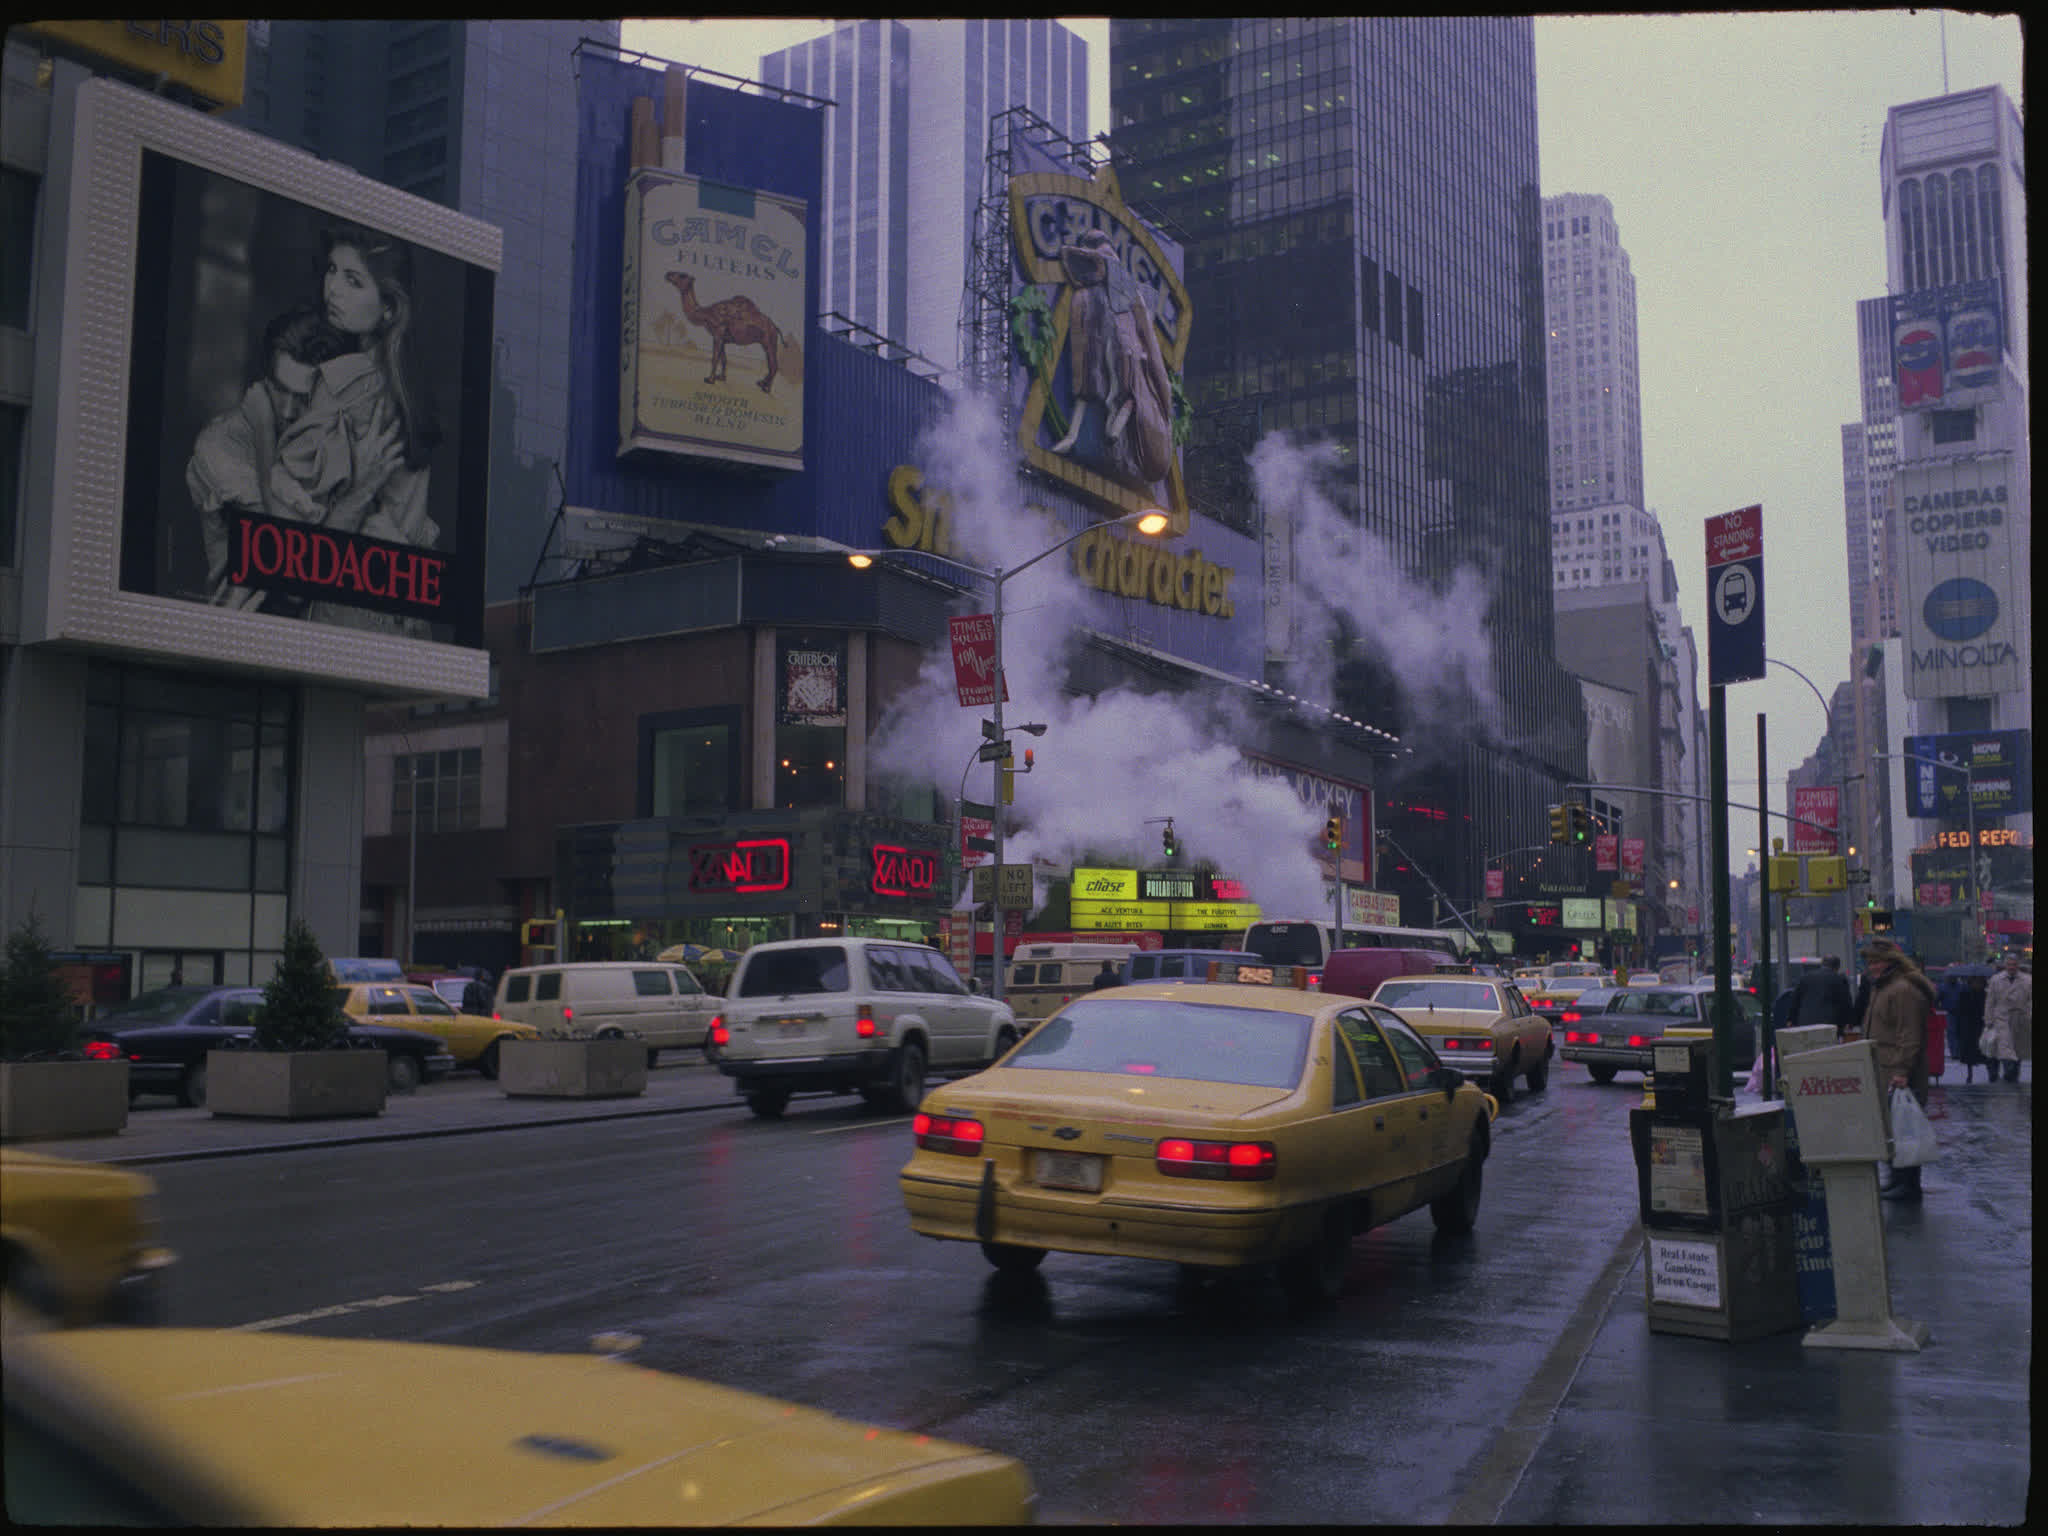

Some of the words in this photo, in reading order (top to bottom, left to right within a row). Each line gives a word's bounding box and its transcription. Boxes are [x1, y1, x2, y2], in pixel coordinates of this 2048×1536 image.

[651, 216, 799, 280] CAMEL
[677, 249, 776, 281] FILTERS
[1904, 486, 2008, 514] CAMERAS
[1724, 514, 1743, 530] NO
[1910, 508, 2002, 534] COPIERS
[1713, 527, 1755, 548] STANDING
[1926, 532, 1989, 555] VIDEO
[232, 519, 441, 607] JORDACHE
[952, 619, 993, 634] TIMES
[953, 631, 994, 646] SQUARE
[788, 654, 837, 667] CRITERION
[1911, 644, 2018, 671] MINOLTA
[1938, 830, 1971, 849] FED
[1007, 870, 1025, 881] NO
[1003, 883, 1026, 893] LEFT
[1002, 896, 1028, 905] TURN
[1660, 1247, 1679, 1260] Real
